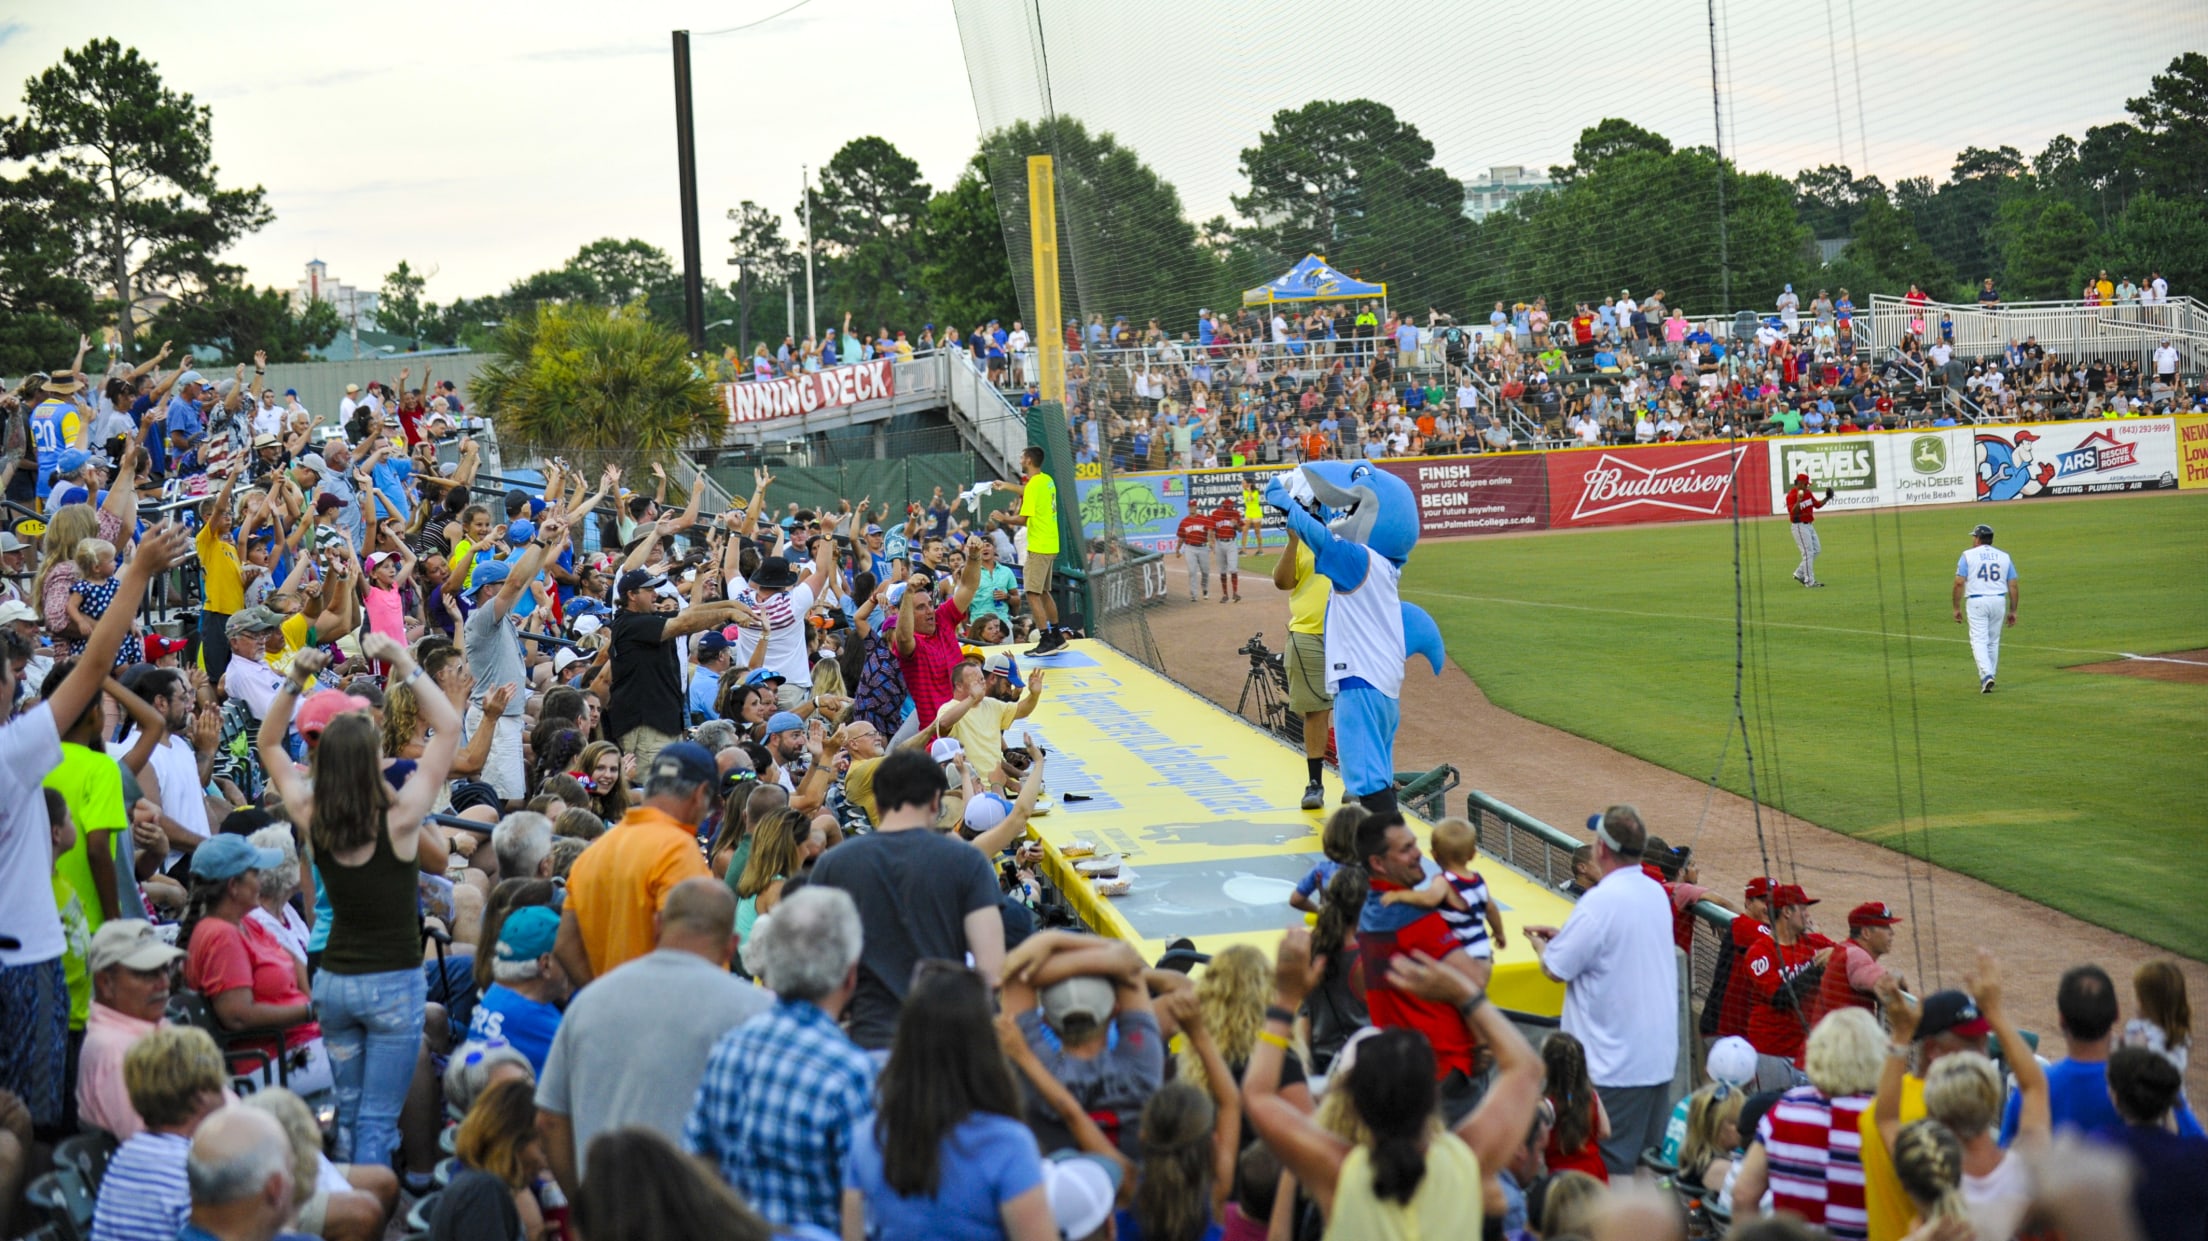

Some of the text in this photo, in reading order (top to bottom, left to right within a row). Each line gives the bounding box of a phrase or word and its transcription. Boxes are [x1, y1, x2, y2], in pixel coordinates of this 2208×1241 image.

[726, 362, 888, 422] INNING DECK
[31, 420, 57, 452] 20
[2100, 446, 2129, 459] RESCUE
[1787, 449, 1871, 485] REVELS
[2062, 451, 2096, 473] ARS
[2101, 454, 2131, 468] ROOTER
[1191, 472, 1244, 484] T-SHIRTS
[1419, 465, 1470, 480] FINISH
[1421, 477, 1512, 490] your USC degree online
[1584, 468, 1731, 501] Budweiser
[1896, 476, 1964, 490] JOHN DEERE
[2052, 482, 2142, 494] HEATING PLUMBING AIR
[1421, 492, 1469, 507] BEGIN
[1906, 490, 1956, 502] Myrtle Beach
[1423, 505, 1505, 518] your future anywhere
[24, 522, 46, 532] 115
[1423, 515, 1536, 530] www.PalmettoCollege.sc.edu
[1977, 563, 2001, 582] 46
